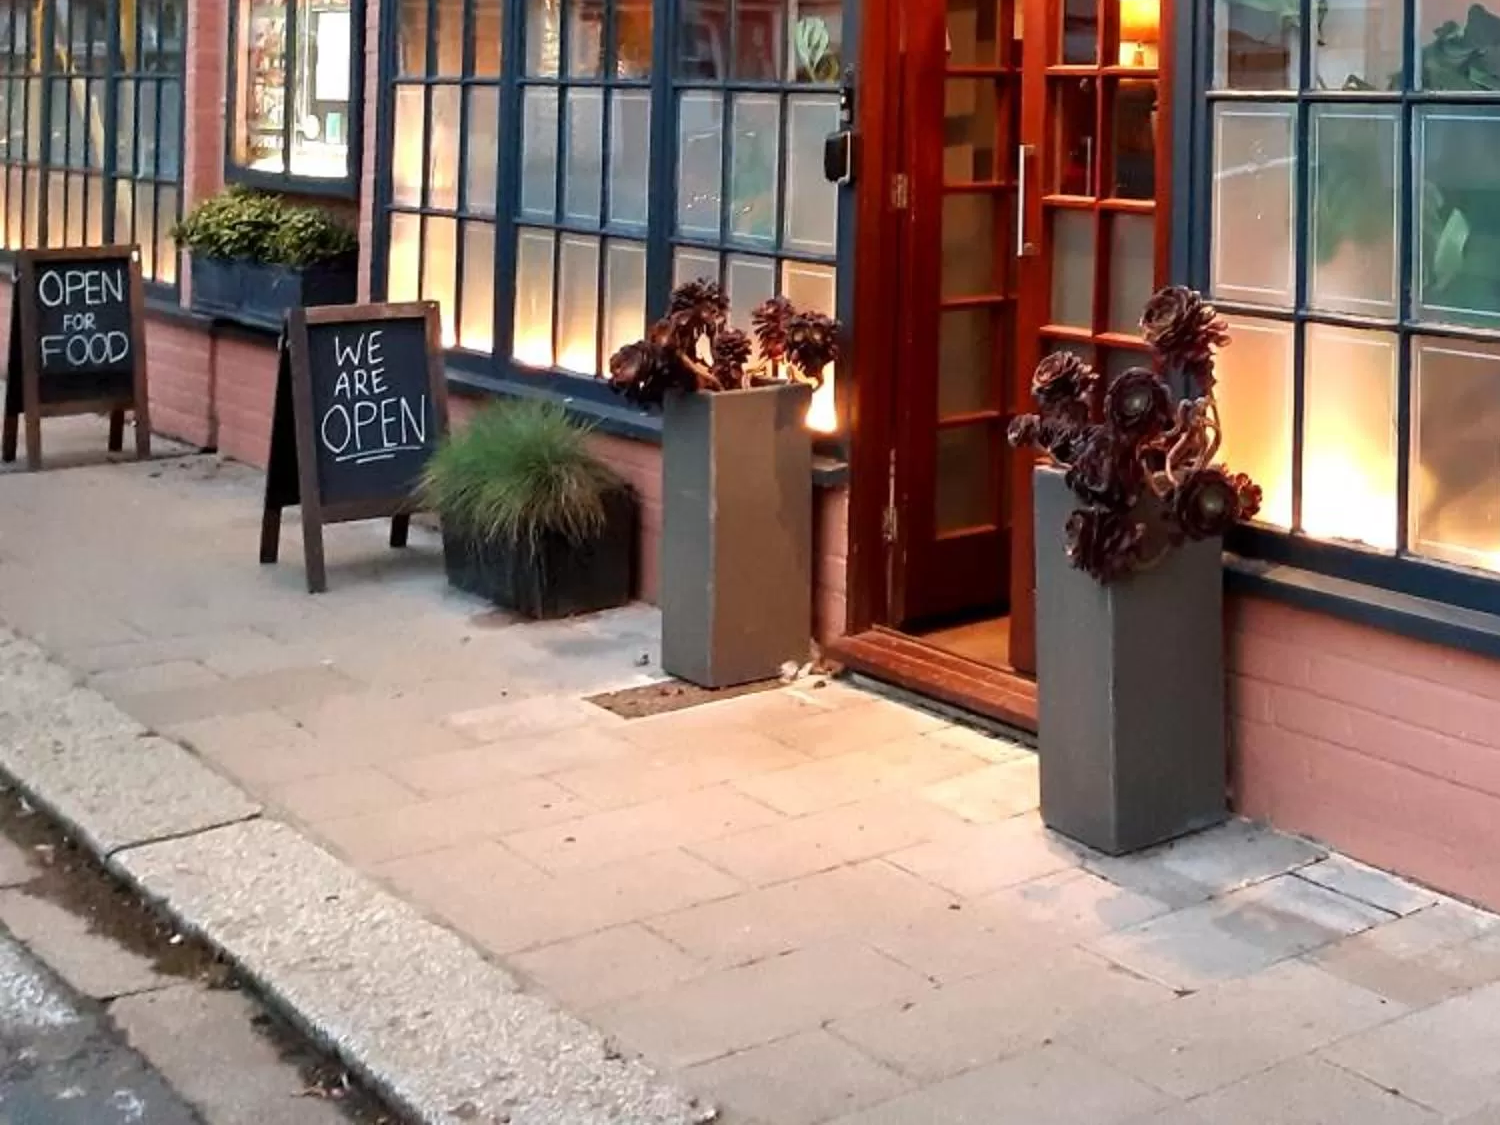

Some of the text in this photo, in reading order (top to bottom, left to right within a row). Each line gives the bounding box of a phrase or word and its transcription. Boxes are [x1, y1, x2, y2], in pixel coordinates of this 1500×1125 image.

[38, 269, 124, 308] OPEN
[63, 312, 96, 332] FOR
[41, 330, 129, 367] FOOD
[334, 330, 385, 367] WE
[334, 368, 389, 400] ARE
[320, 394, 426, 454] OPEN
